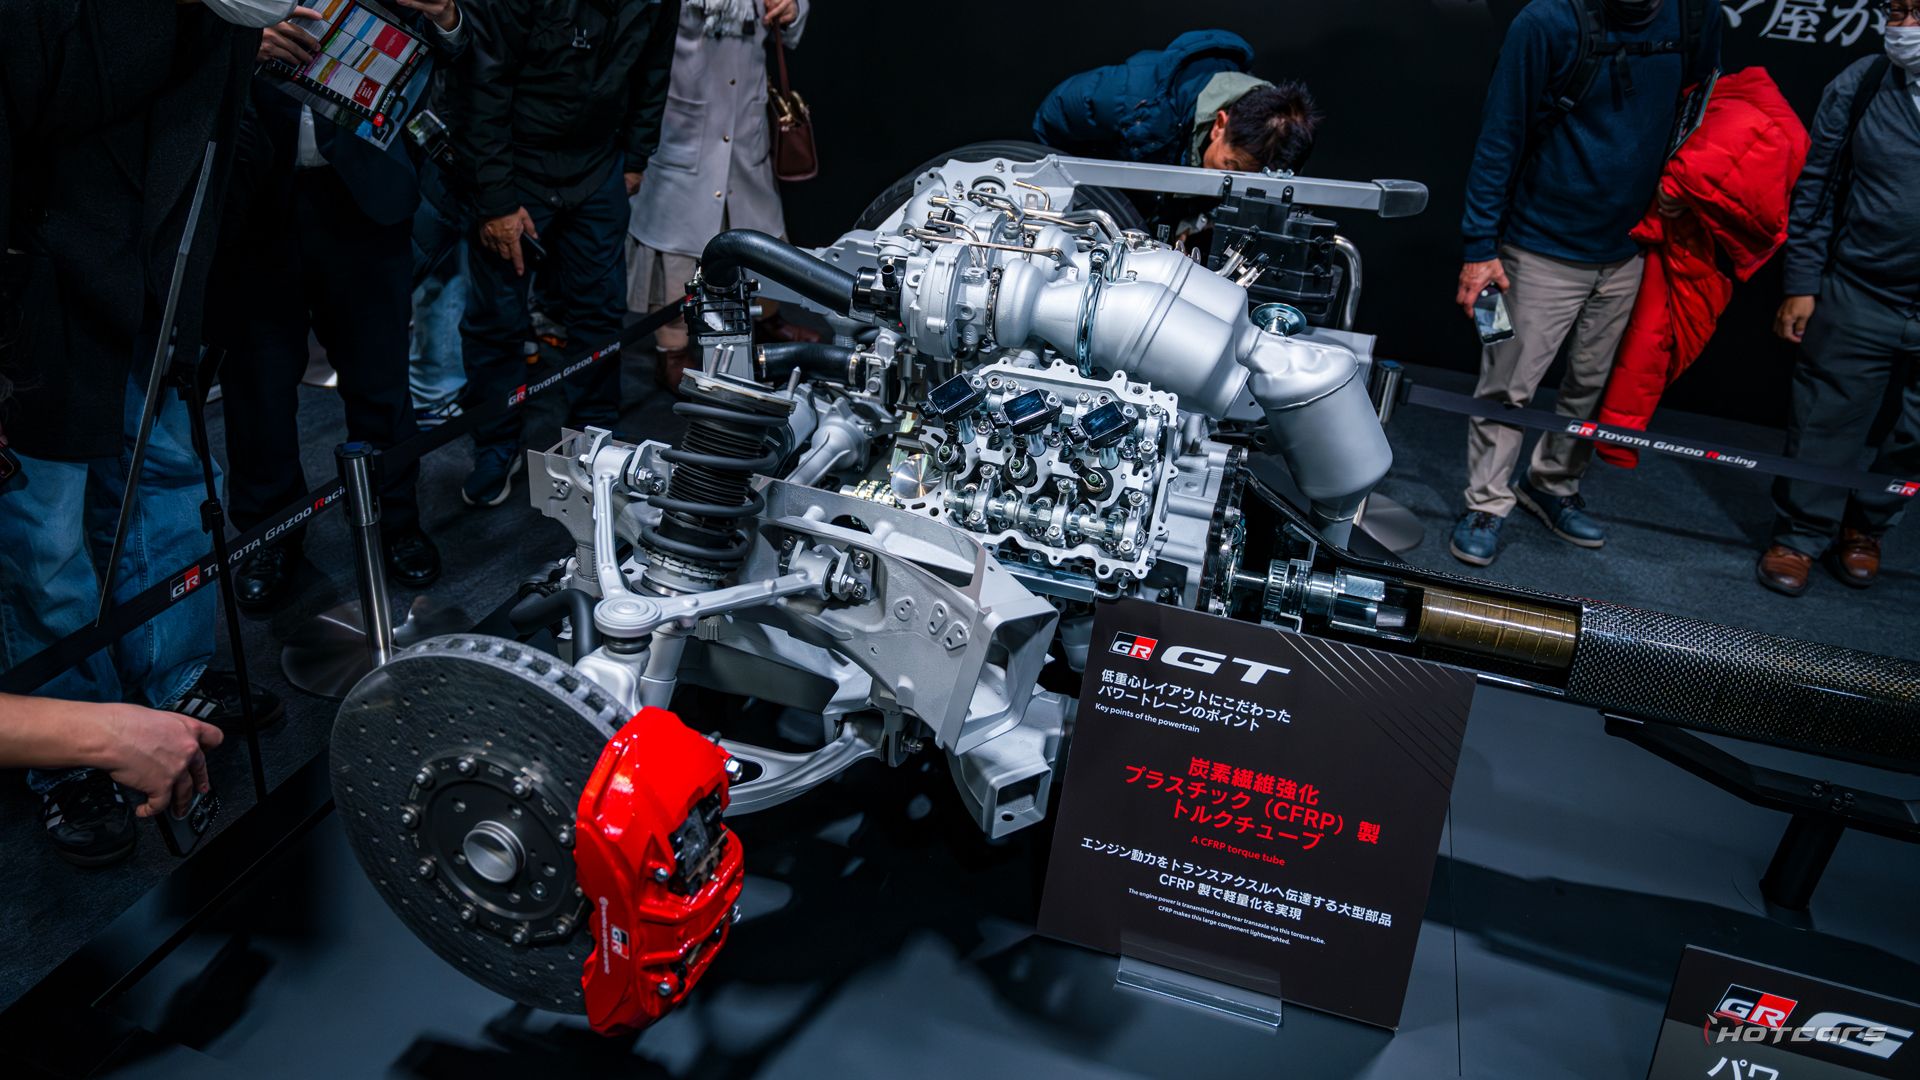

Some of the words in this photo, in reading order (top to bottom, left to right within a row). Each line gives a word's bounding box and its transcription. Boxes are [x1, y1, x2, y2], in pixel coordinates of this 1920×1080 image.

[528, 373, 562, 395] TOYOTA
[563, 356, 592, 377] GAZOO
[1566, 423, 1595, 437] GR
[1597, 429, 1650, 447] TOYOTA
[1653, 441, 1704, 457] GAZOO
[1706, 450, 1758, 469] Racing
[1887, 481, 1919, 497] GR
[171, 572, 199, 599] GR
[265, 507, 312, 541] GAZOO
[313, 486, 346, 512] Raci
[1111, 638, 1151, 660] GR
[1160, 645, 1291, 685] GT
[1095, 702, 1109, 713] Key
[1110, 707, 1134, 718] points
[1144, 714, 1157, 723] the
[1158, 718, 1200, 733] powertrain
[1098, 686, 1260, 732] パワートレーンのポイント
[1101, 668, 1291, 723] 低重心レイアウトにこだわった
[1188, 757, 1319, 806] 炭素繊維強化
[1174, 799, 1325, 850] トルクチューブ
[1191, 835, 1199, 844] A
[1200, 838, 1226, 850] CFRP
[1227, 844, 1261, 859] torque
[1262, 853, 1286, 866] tube
[1080, 837, 1392, 927] エンジン動力をトランスアクスルへ伝達する大型部品
[1128, 887, 1139, 895] The
[1139, 891, 1158, 900] engine
[1158, 896, 1176, 905] power
[1182, 902, 1214, 915] transmitted
[1243, 918, 1270, 930] transaxle
[1279, 928, 1290, 936] this
[1291, 931, 1310, 940] torque
[1310, 936, 1326, 945] tube.
[1158, 905, 1173, 913] CFRP
[1173, 910, 1191, 919] makes
[1202, 917, 1217, 925] large
[1217, 921, 1249, 934] component
[1249, 929, 1291, 945] lightweighted.
[1718, 997, 1786, 1030] GR
